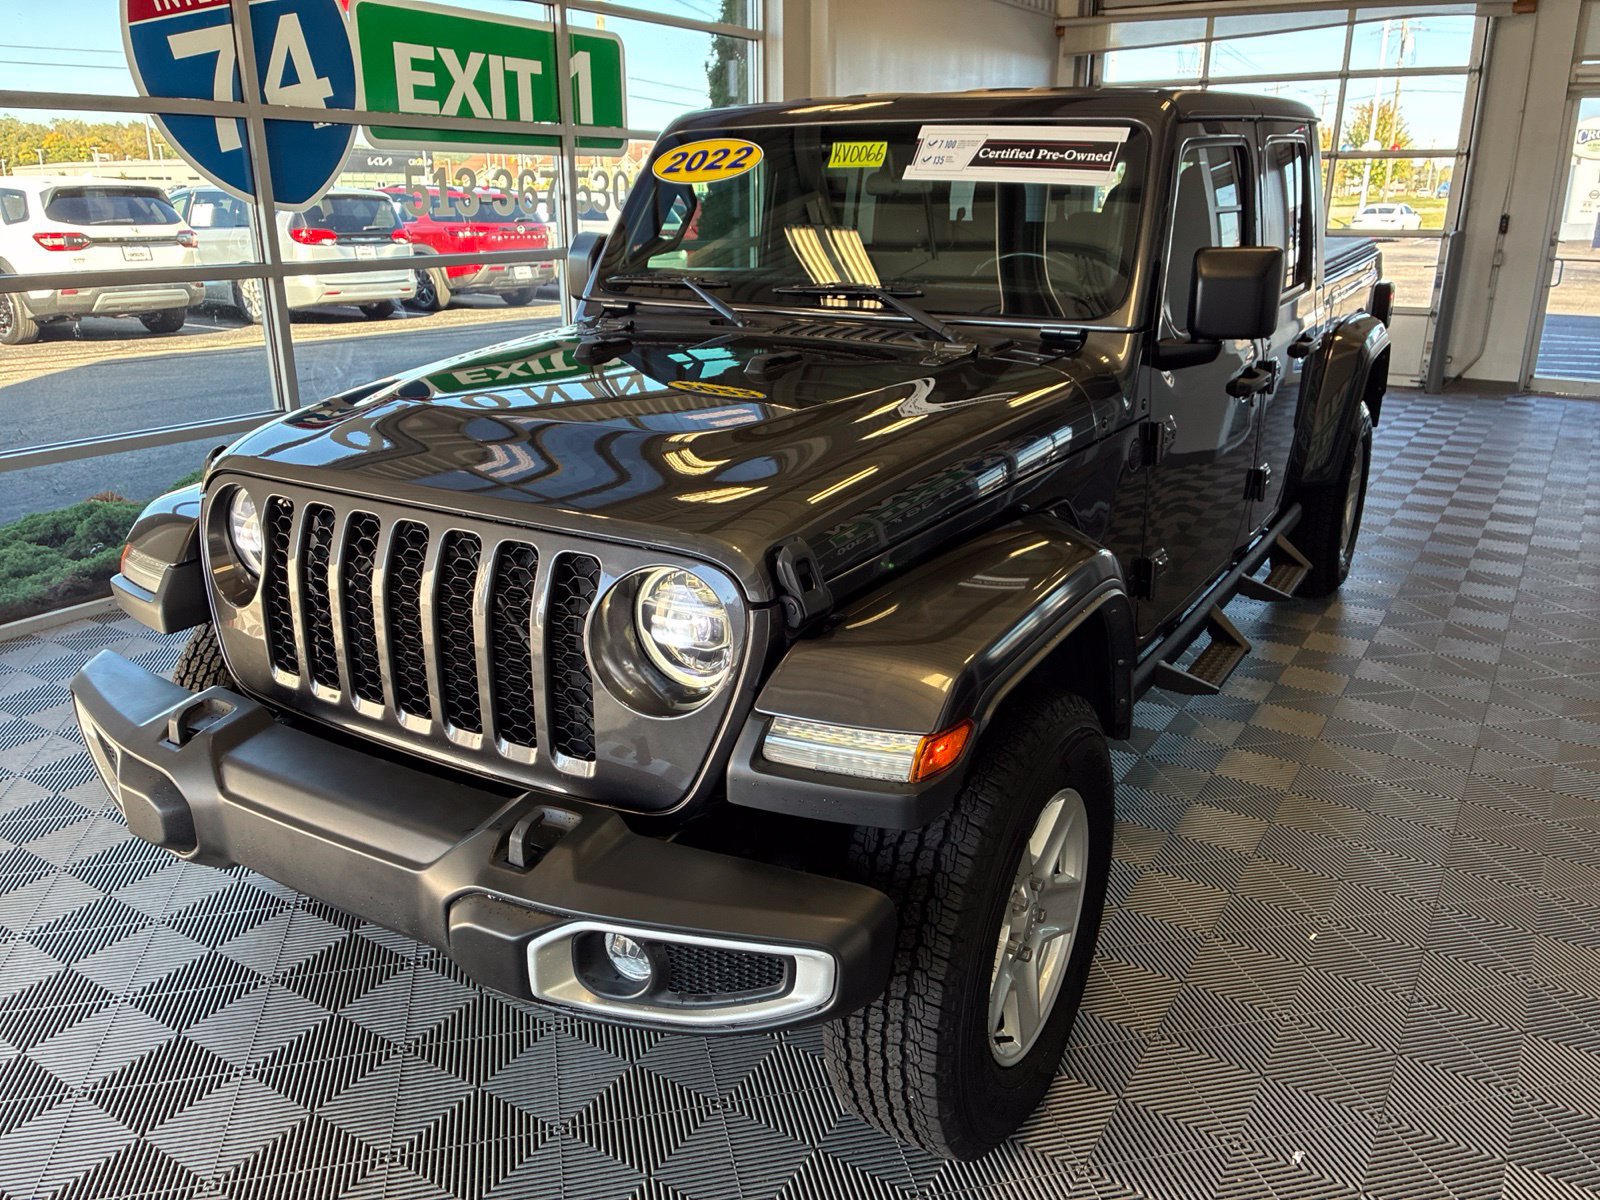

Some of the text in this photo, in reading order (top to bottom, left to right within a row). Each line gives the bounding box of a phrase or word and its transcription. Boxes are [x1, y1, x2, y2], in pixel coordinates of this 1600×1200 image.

[167, 13, 334, 152] 74
[393, 41, 594, 124] EXIT 1
[661, 146, 754, 174] 2022
[978, 147, 1113, 163] Certified Pre-Owned
